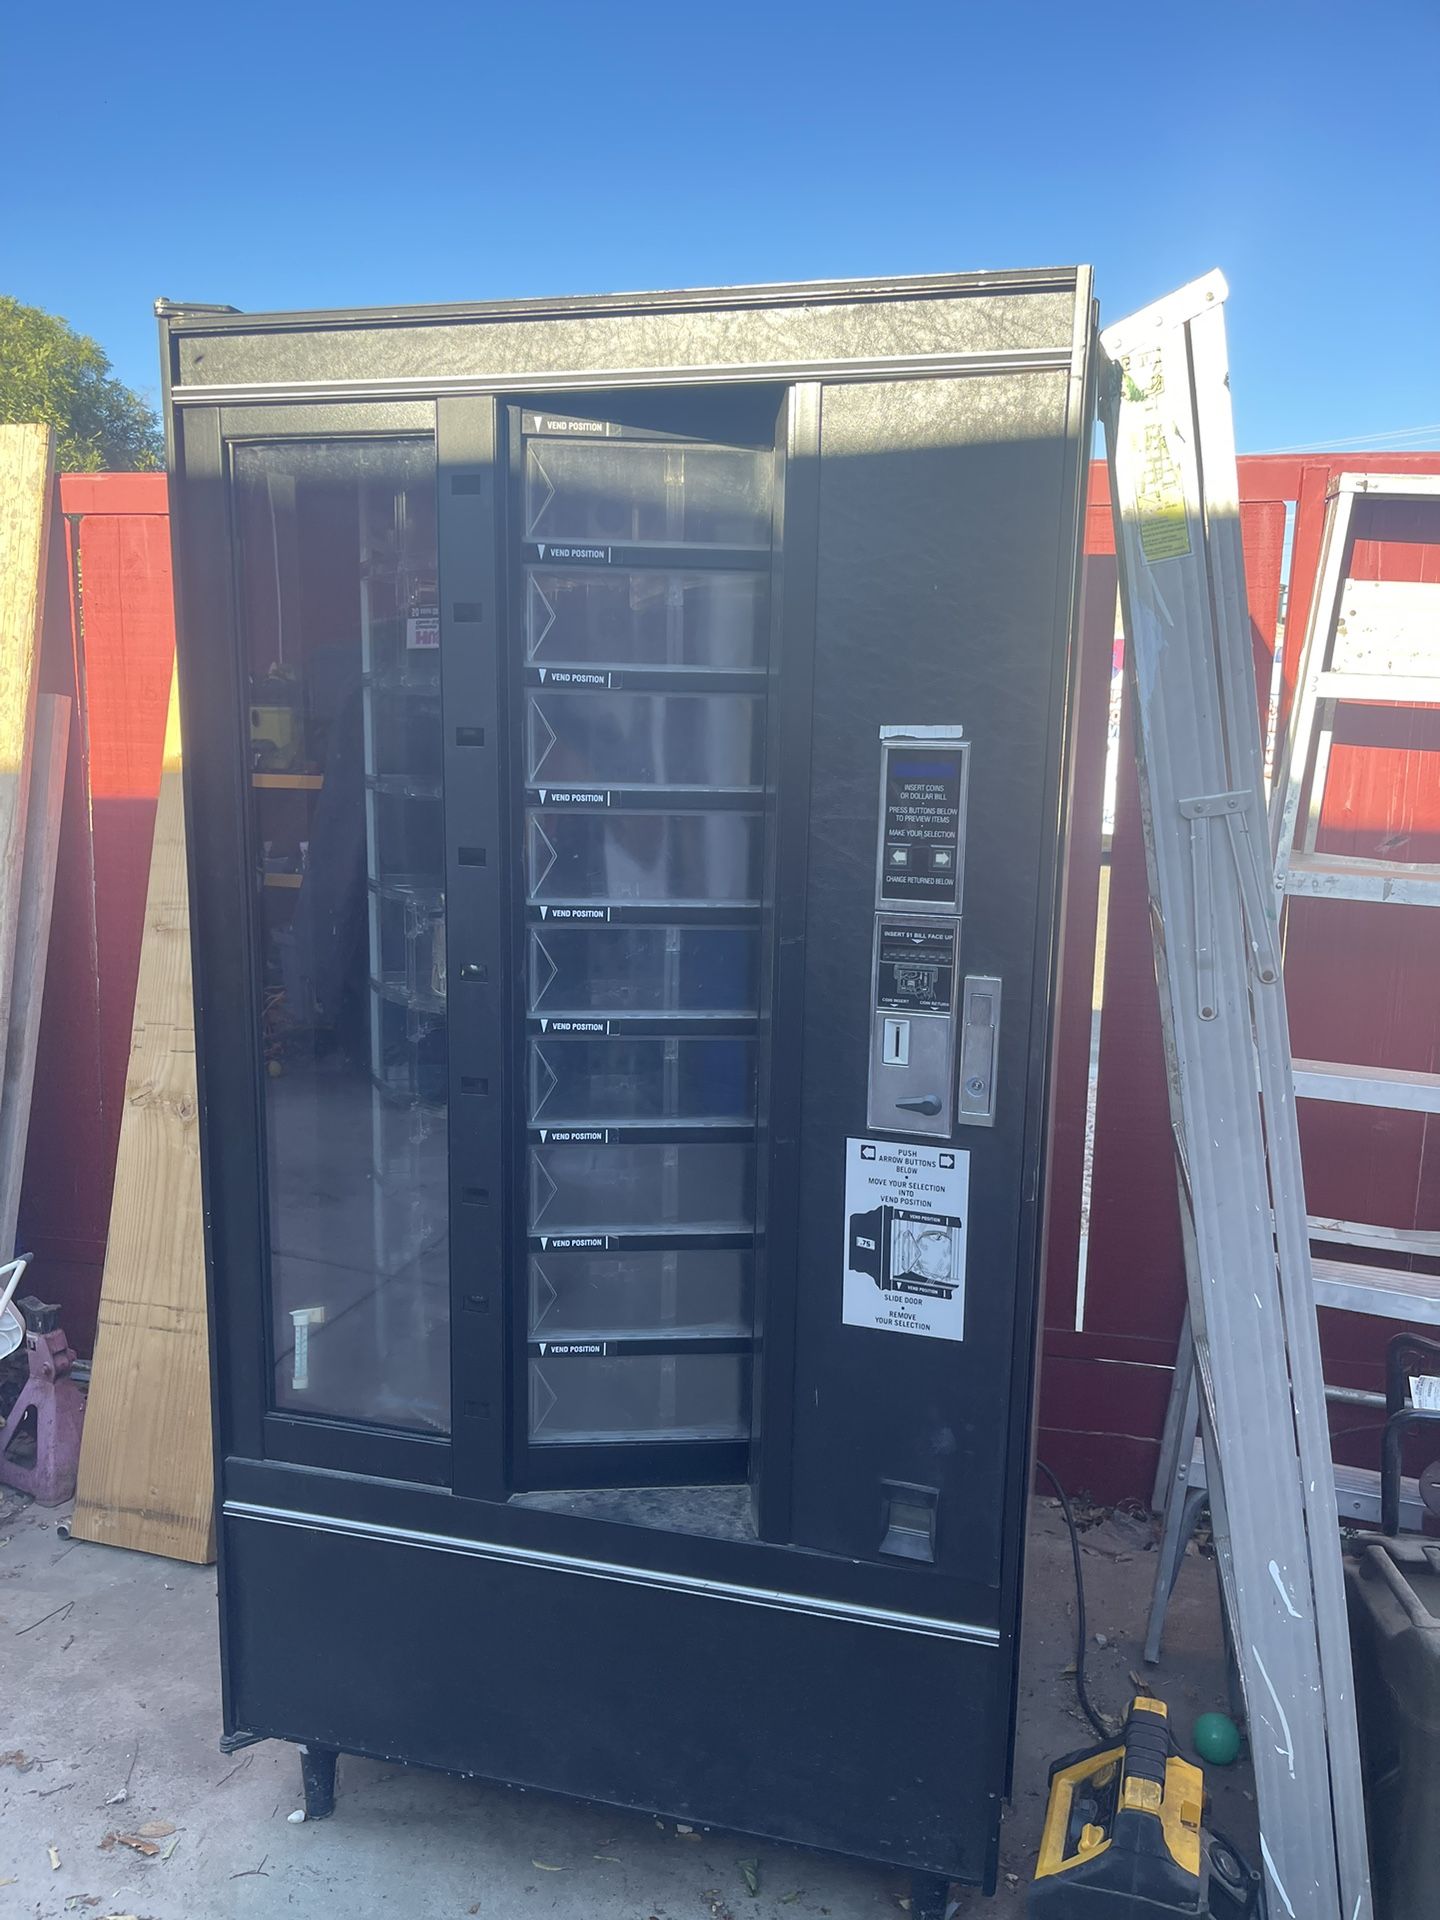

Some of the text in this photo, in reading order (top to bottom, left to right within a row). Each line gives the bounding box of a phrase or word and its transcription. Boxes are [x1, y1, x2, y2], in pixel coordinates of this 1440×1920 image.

[547, 421, 602, 432] VEND POSITION
[550, 548, 604, 559] VEND POSITION
[551, 673, 605, 684] VEND POSITION
[925, 784, 945, 792] COINS
[551, 793, 604, 802] VEND POSITION
[900, 792, 947, 801] OR DOLLAR BILL
[889, 806, 958, 816] PRESS BUTTONS BELOW
[904, 815, 931, 823] PREVIEW
[931, 816, 950, 824] ITEMS
[889, 829, 956, 838] MAKE YOUR SELECTION
[886, 875, 954, 886] CHANGE RETURNED BELOW
[552, 909, 604, 918] VEND POSITION
[552, 1022, 604, 1031] VEND POSITION
[551, 1132, 602, 1140] VEND POSITION
[898, 1149, 918, 1158] PUSH
[879, 1155, 937, 1168] ARROW BUTTONS
[896, 1166, 918, 1174] BELOW
[868, 1177, 946, 1193] MOVE YOUR SELECTION
[898, 1189, 914, 1198] INTO
[880, 1195, 932, 1208] VEND POSITION
[552, 1239, 602, 1247] VEND POSITION
[884, 1294, 923, 1306] SLIDE DOOR
[888, 1310, 917, 1321] REMOVE
[875, 1316, 931, 1331] YOUR SELECTION
[550, 1345, 600, 1353] VEND POSITION
